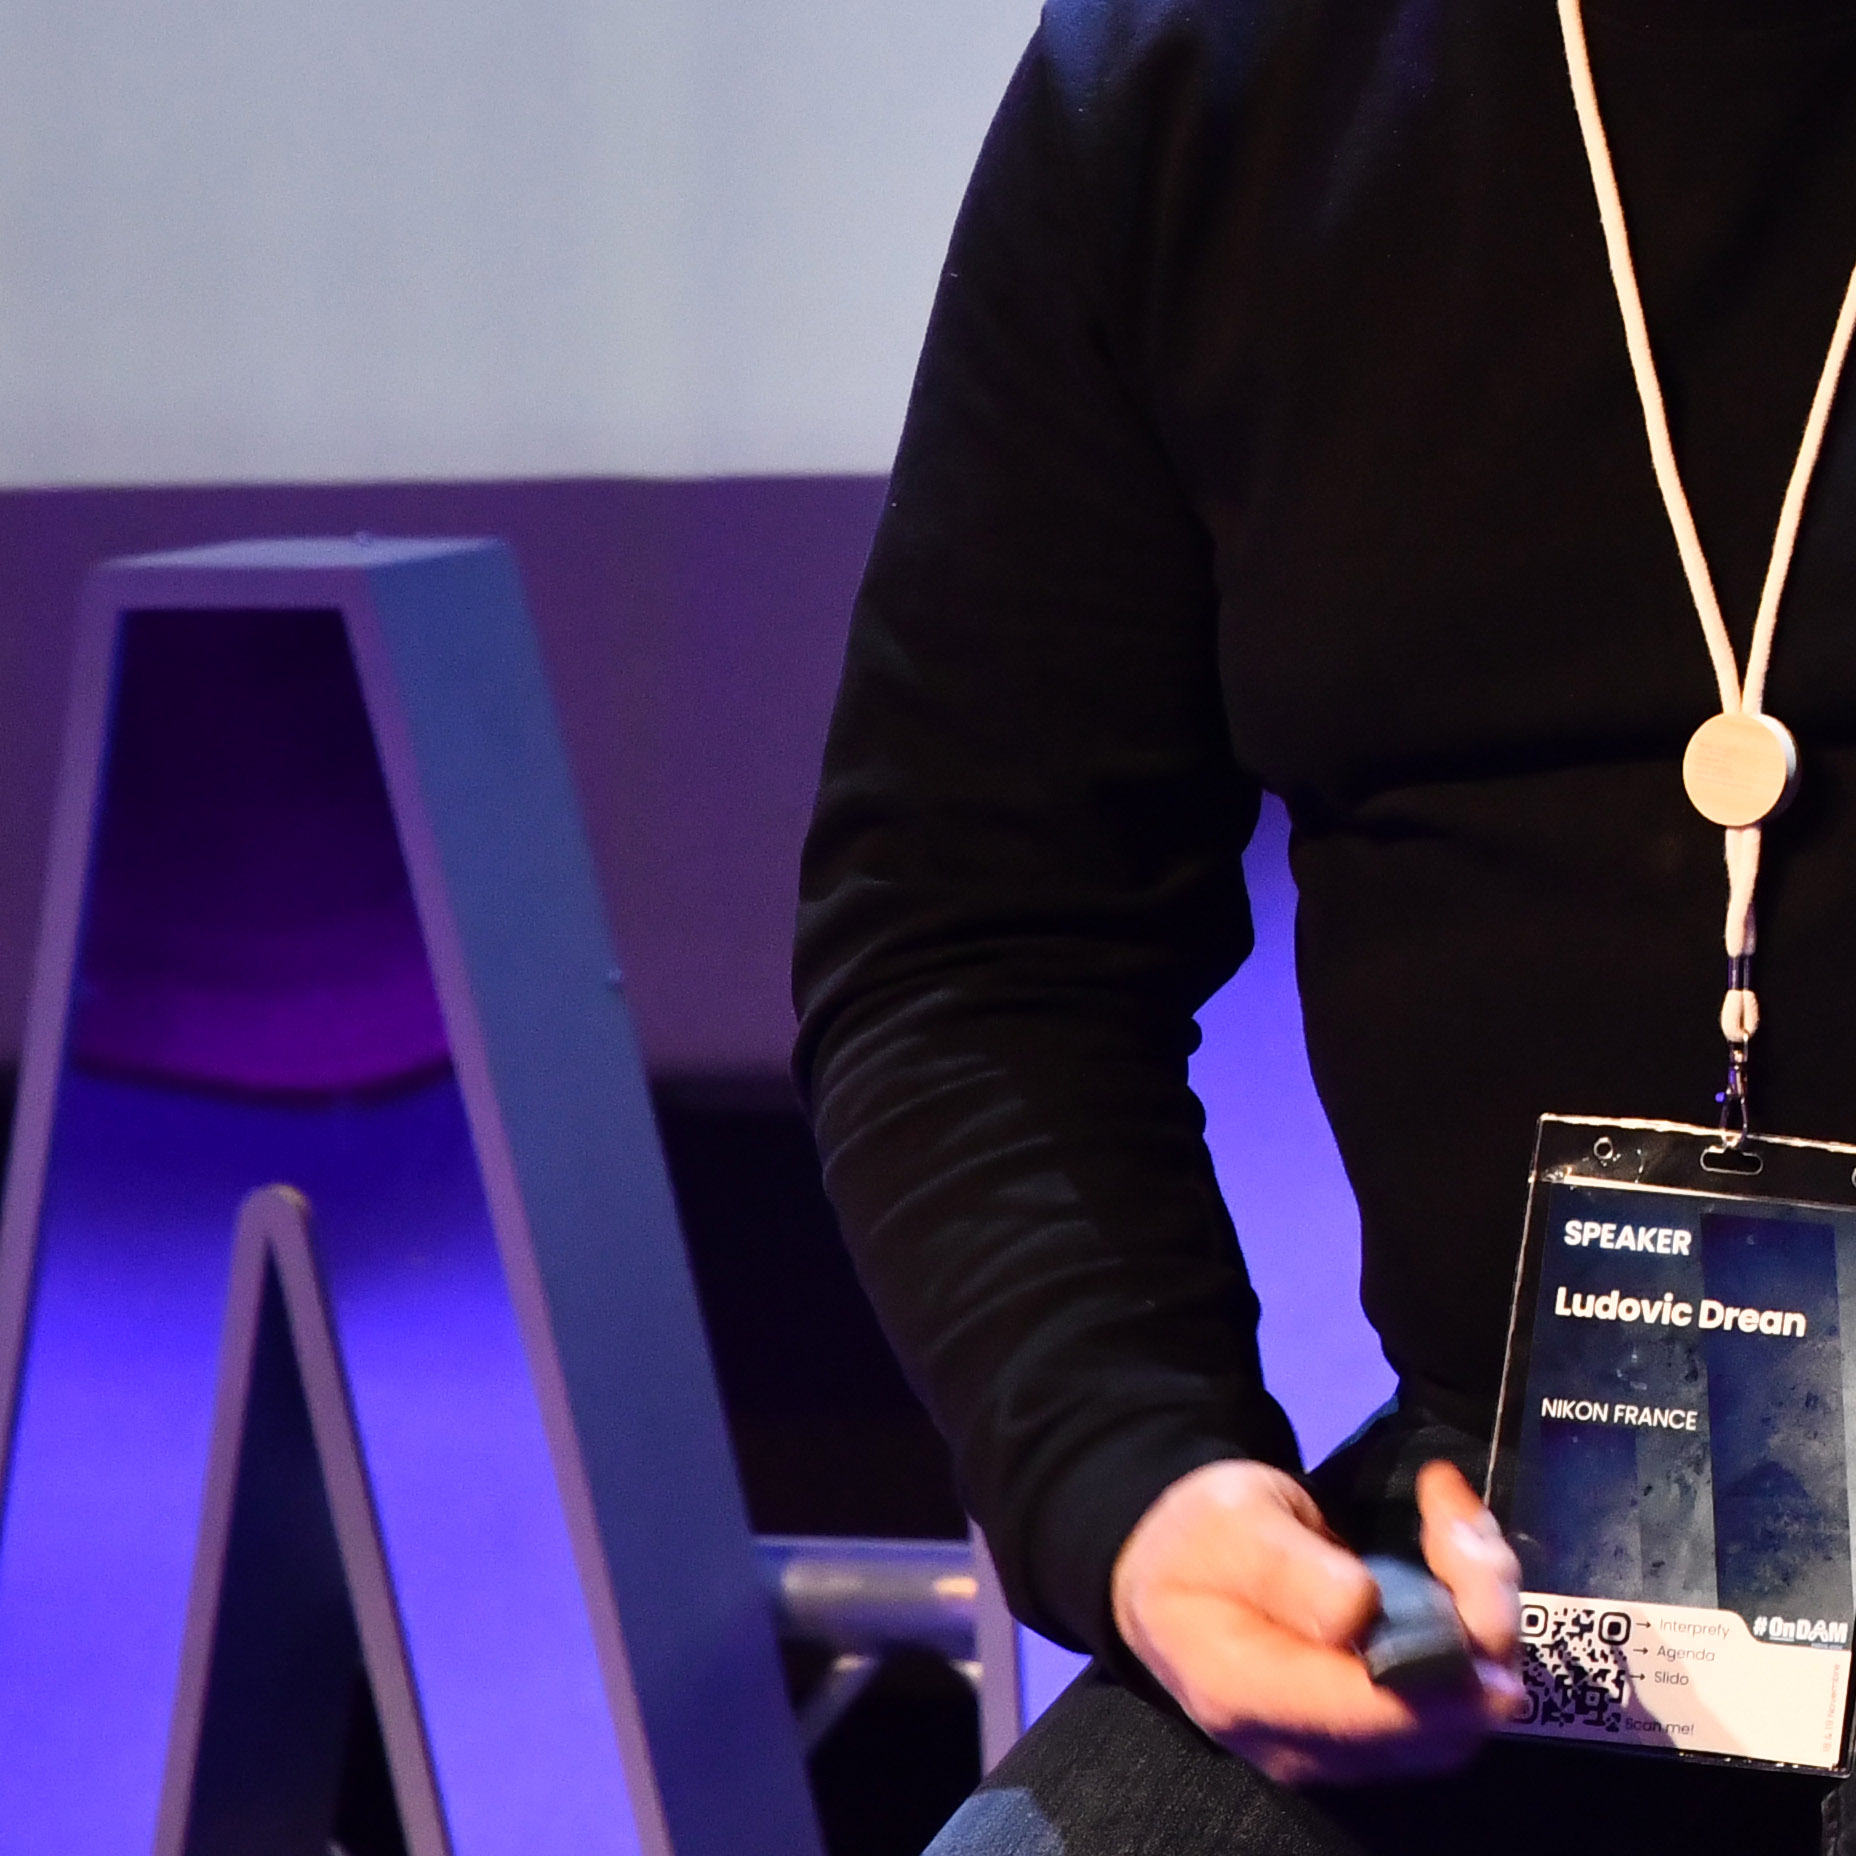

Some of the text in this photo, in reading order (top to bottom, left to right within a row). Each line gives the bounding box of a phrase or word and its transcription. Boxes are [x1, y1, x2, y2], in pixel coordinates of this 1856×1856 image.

[1563, 1219, 1693, 1256] SPEAKER
[1553, 1286, 1807, 1339] Ludovic Drean
[1540, 1396, 1699, 1432] NIKON FRANCE
[1659, 1618, 1731, 1641] Interprefy
[1656, 1645, 1717, 1664] Agenda
[1653, 1670, 1690, 1687] Slido
[1624, 1716, 1695, 1736] Scan me!
